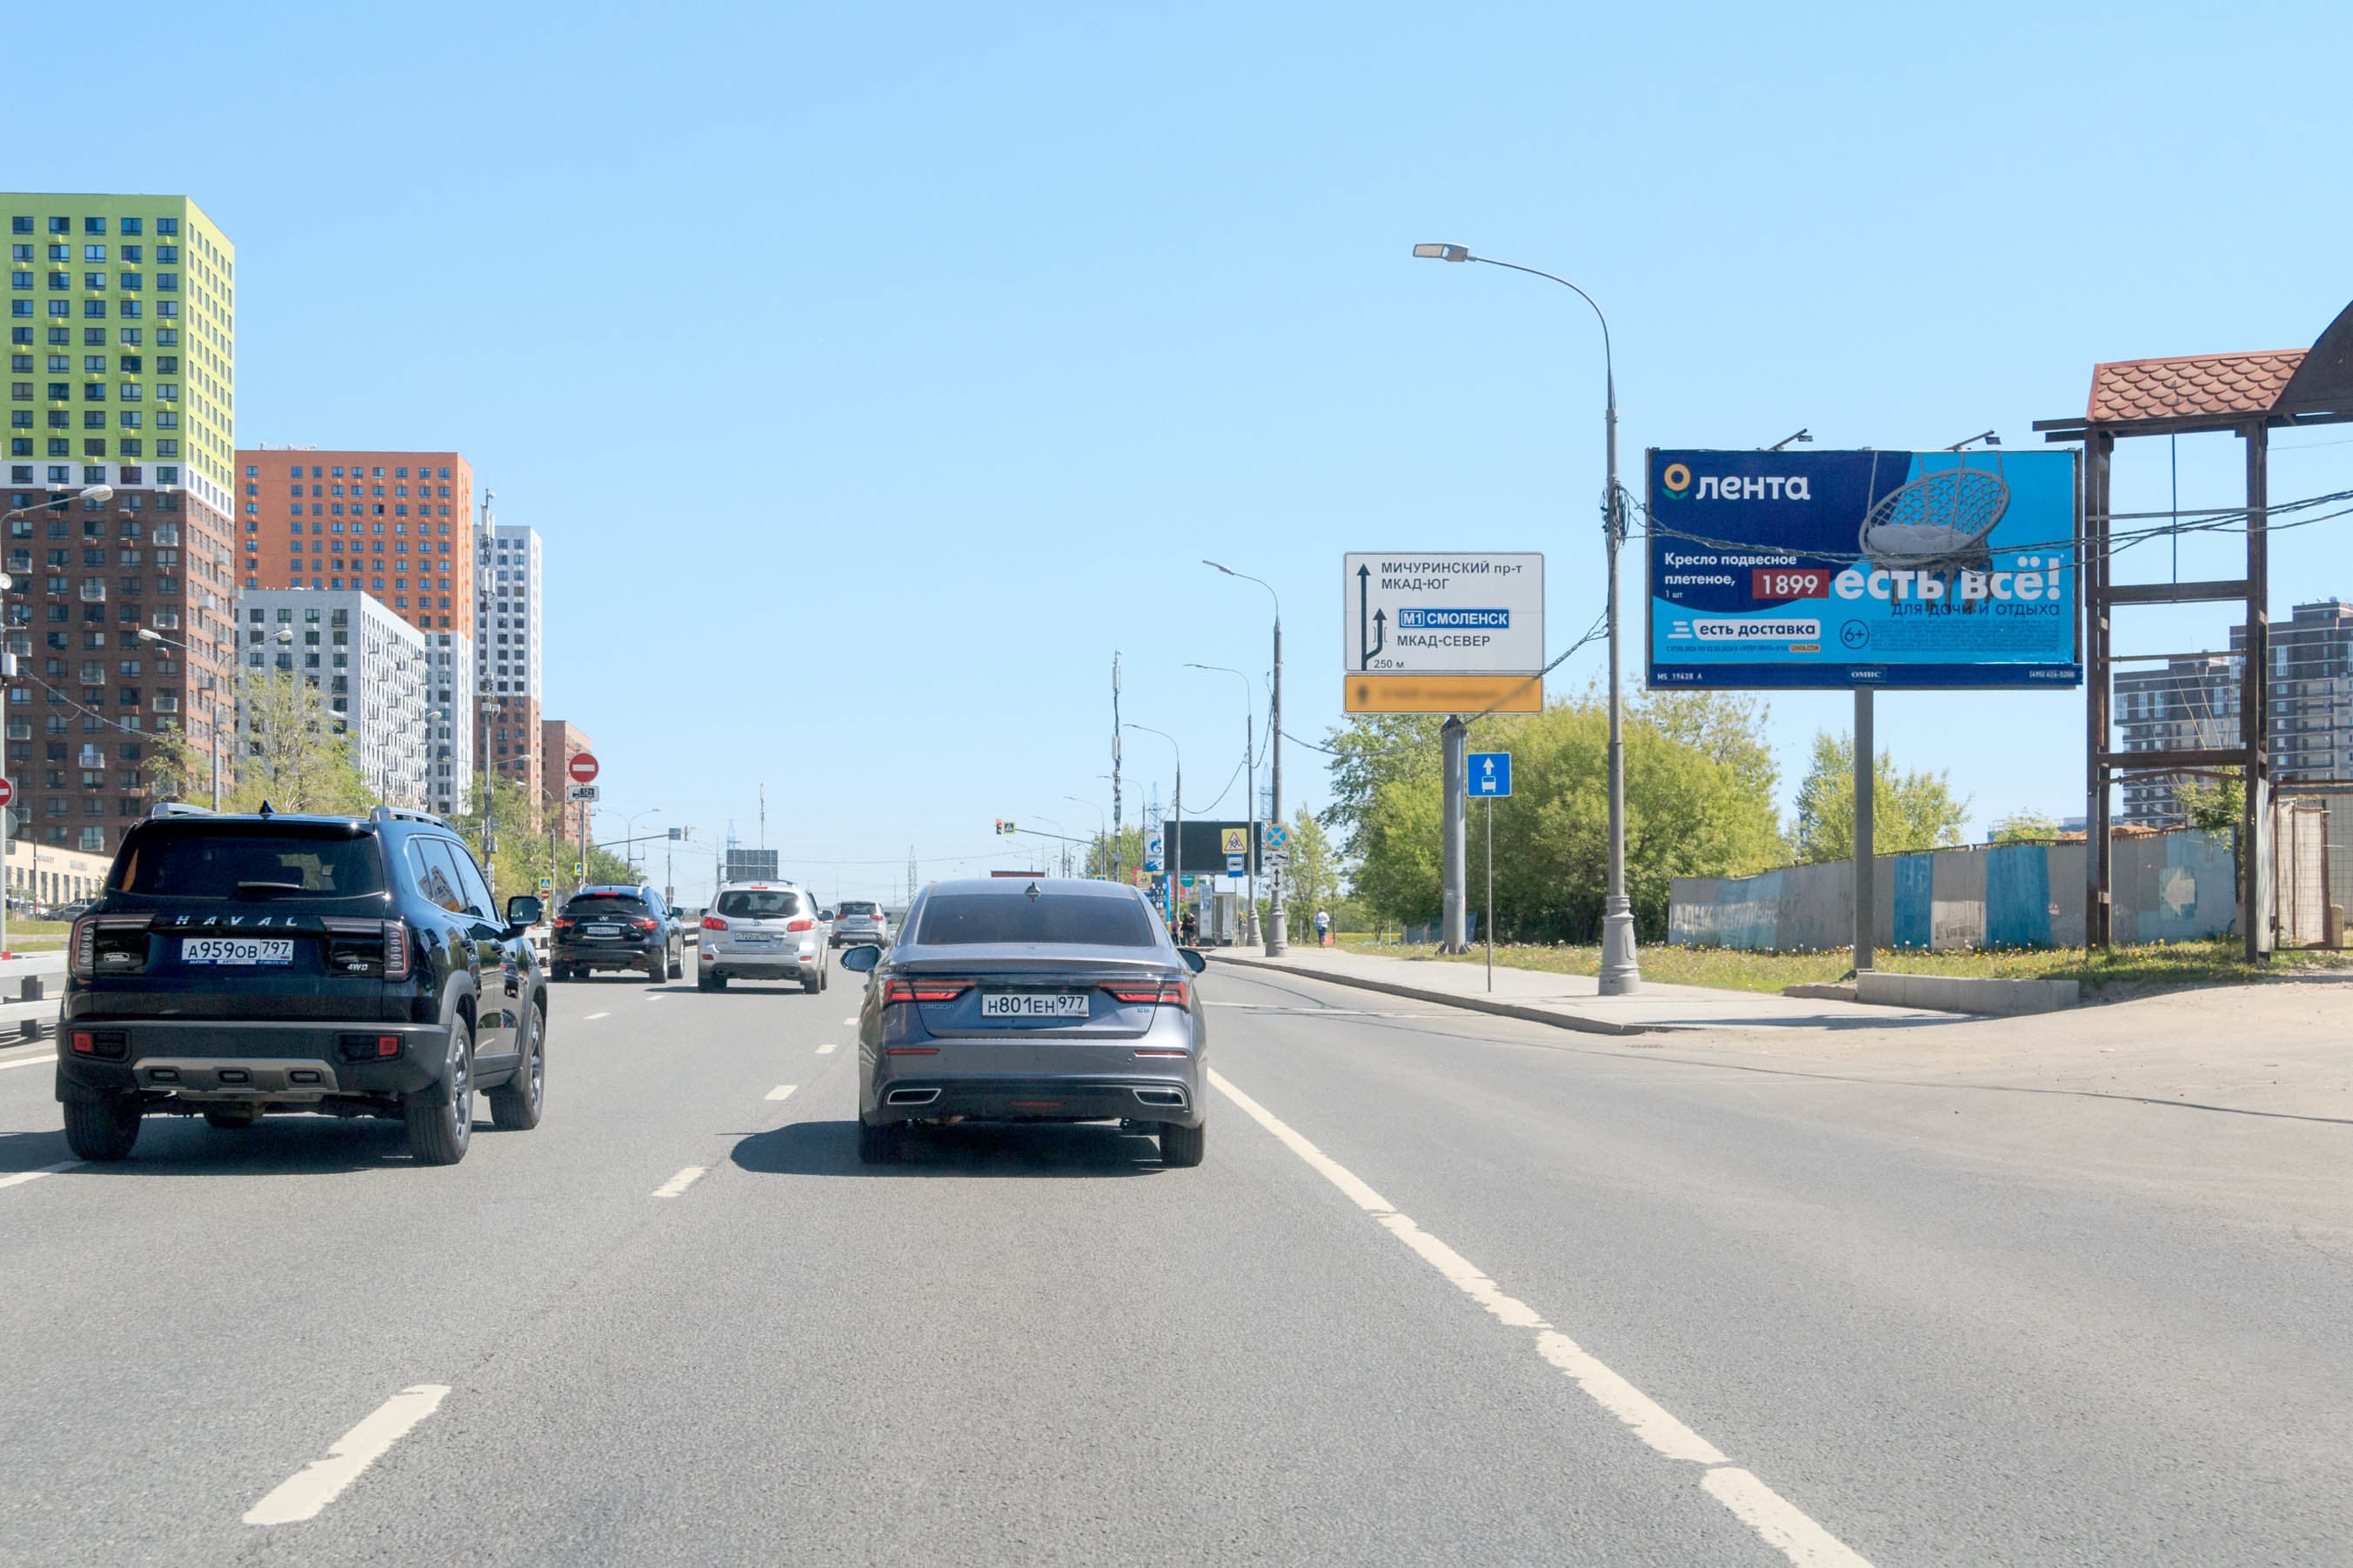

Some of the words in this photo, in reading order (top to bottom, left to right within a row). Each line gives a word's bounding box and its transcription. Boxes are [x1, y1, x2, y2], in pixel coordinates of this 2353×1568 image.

[1695, 476, 1811, 500] лента
[1664, 552, 1717, 568] Кресло
[1721, 555, 1797, 567] подвесное
[1381, 560, 1489, 574] МИЧУРИНСКИЙ
[1494, 564, 1523, 577] пр-т
[1381, 578, 1450, 591] МКАД-ЮГ
[1664, 575, 1735, 586] плетеное,
[1762, 574, 1819, 595] 1899
[1834, 569, 1944, 600] есть
[1960, 556, 2062, 601] всё!
[1891, 603, 1922, 617] для
[1928, 603, 1973, 617] дачи
[1979, 604, 1989, 616] и
[1995, 603, 2061, 618] отдыха
[1427, 612, 1507, 625] СМОЛЕНСК
[1700, 624, 1734, 635] есть
[1737, 624, 1816, 637] доставка
[1843, 628, 1865, 642] 6+
[1397, 635, 1491, 648] МКАД-СЕВЕР
[1374, 659, 1393, 669] 250
[175, 916, 297, 926] HAVAL
[188, 942, 257, 958] А959ОВ
[262, 941, 290, 955] 797
[987, 997, 1055, 1013] Н801ЕН
[1058, 996, 1084, 1009] 977
